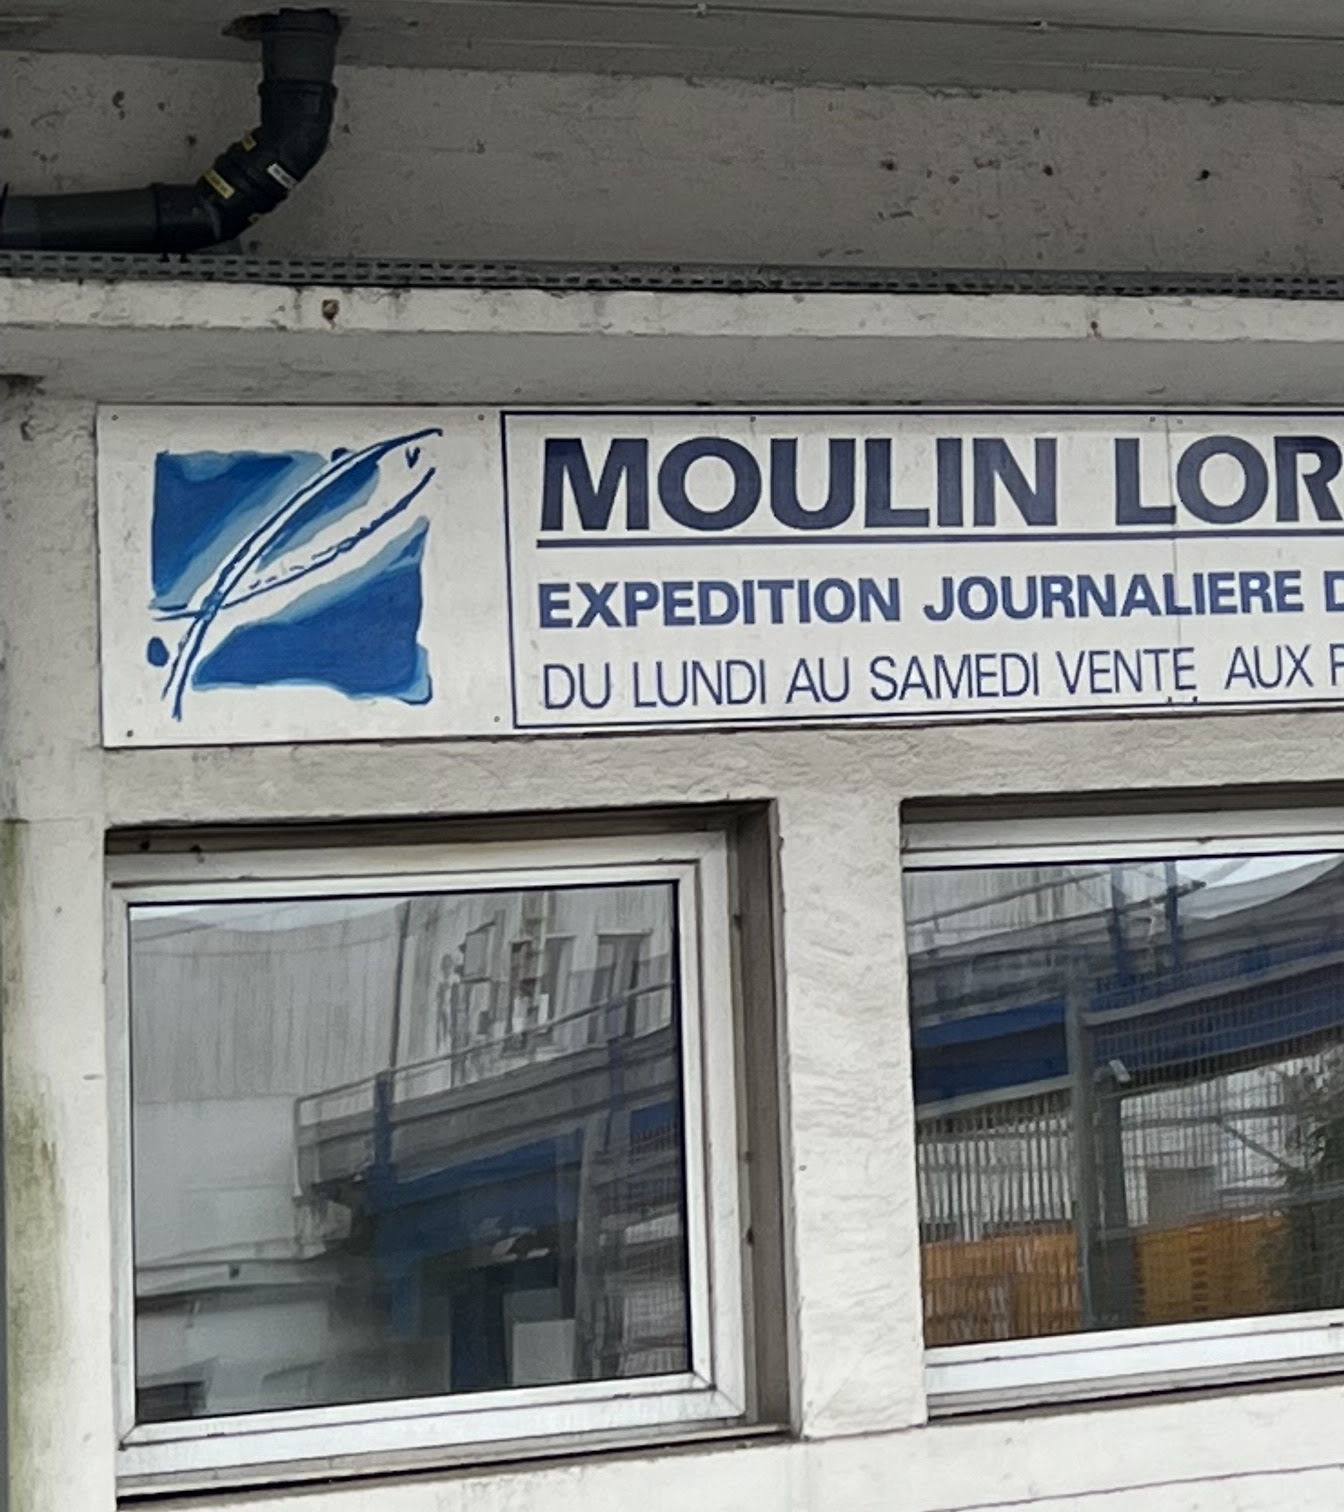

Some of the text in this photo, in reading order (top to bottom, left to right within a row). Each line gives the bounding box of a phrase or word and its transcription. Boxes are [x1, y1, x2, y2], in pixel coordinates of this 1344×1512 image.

[540, 436, 1058, 532] MOULIN
[538, 576, 901, 629] EXPEDITION
[923, 570, 1304, 621] JOURNALIERE
[543, 662, 611, 710] DU
[633, 659, 767, 708] LUNDI
[785, 656, 850, 704] AU
[869, 652, 1039, 702] SAMEDI
[1056, 647, 1197, 695] VENTE
[1224, 644, 1314, 690] AUX
